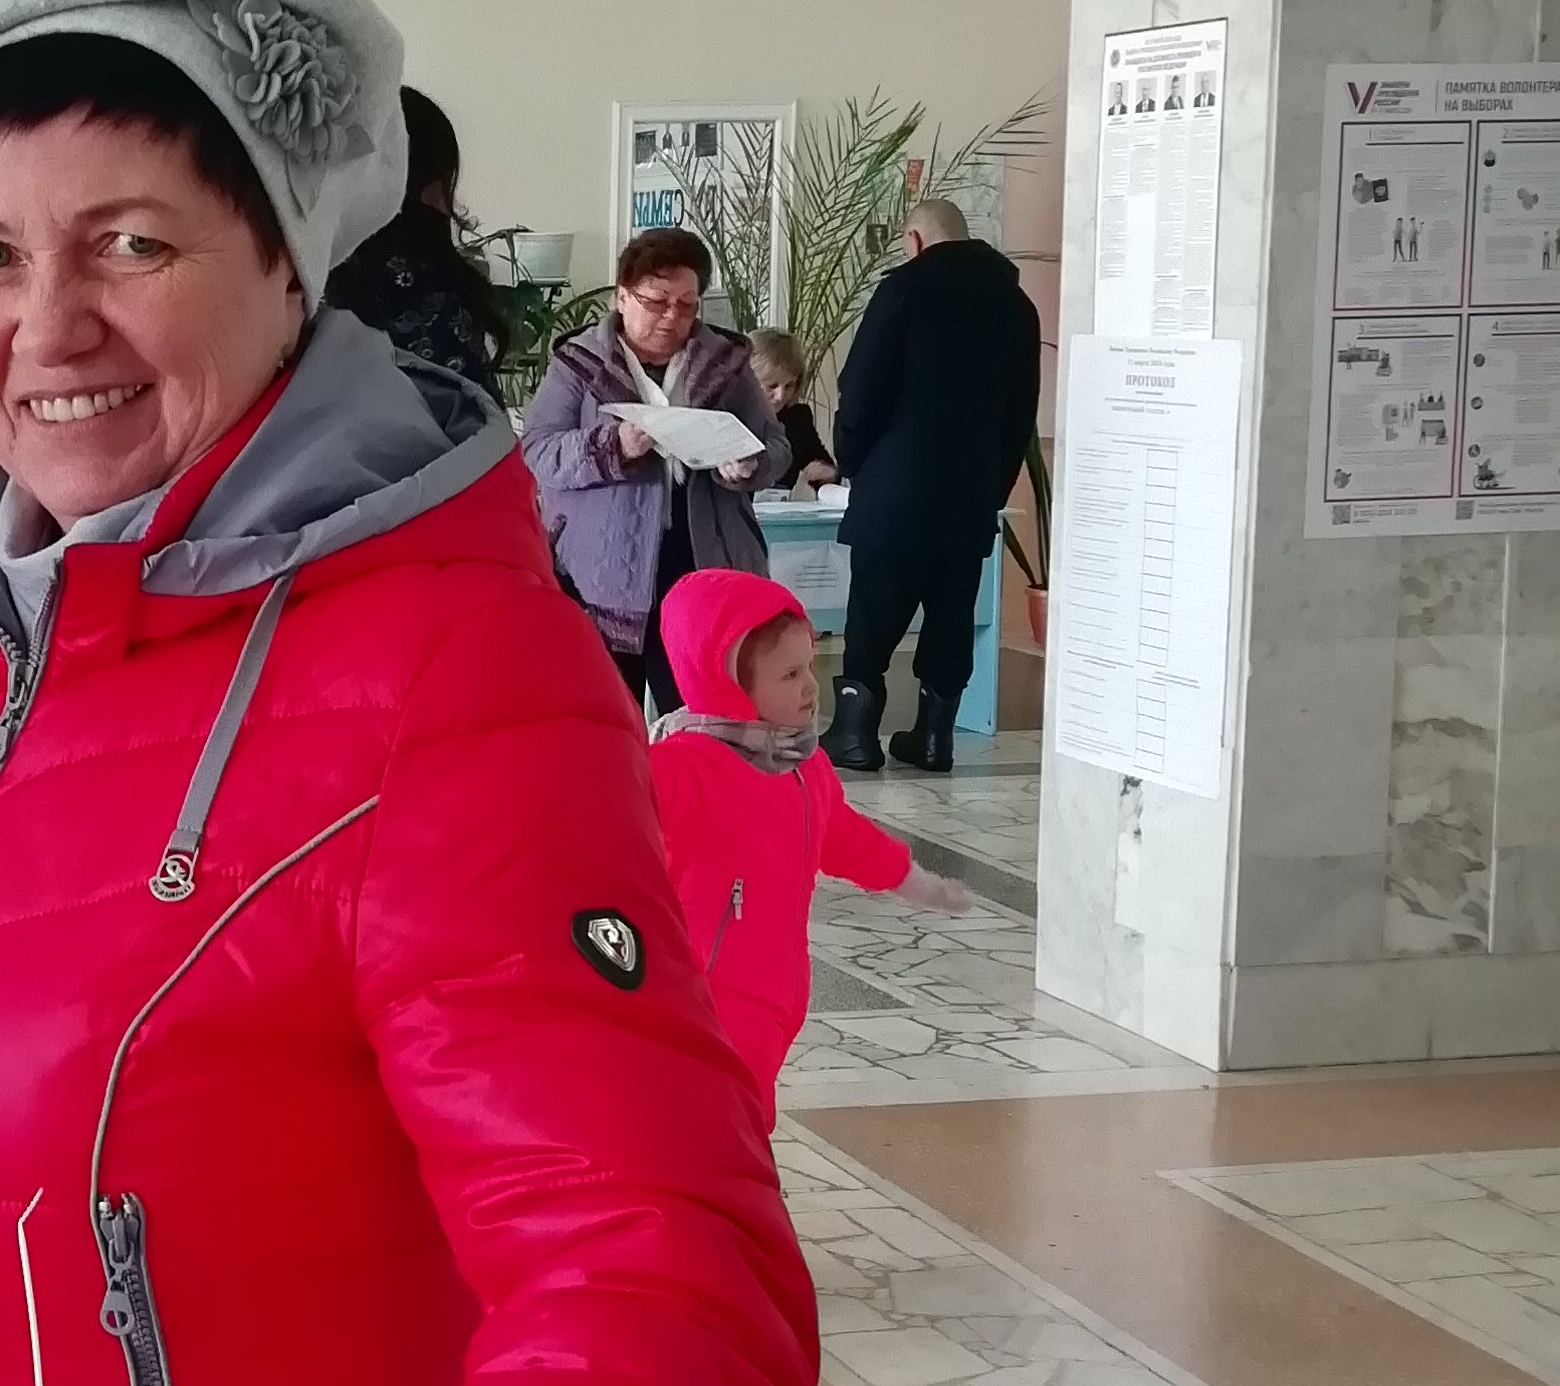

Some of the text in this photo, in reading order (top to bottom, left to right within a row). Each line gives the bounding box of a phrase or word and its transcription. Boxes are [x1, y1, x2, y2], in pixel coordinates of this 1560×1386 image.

[1445, 80, 1560, 94] ПАМЯТКА ВОЛОНТЕРА
[1444, 98, 1514, 111] НА ВЫБОРАХ
[1125, 374, 1176, 389] ПРОТОКОЛ
